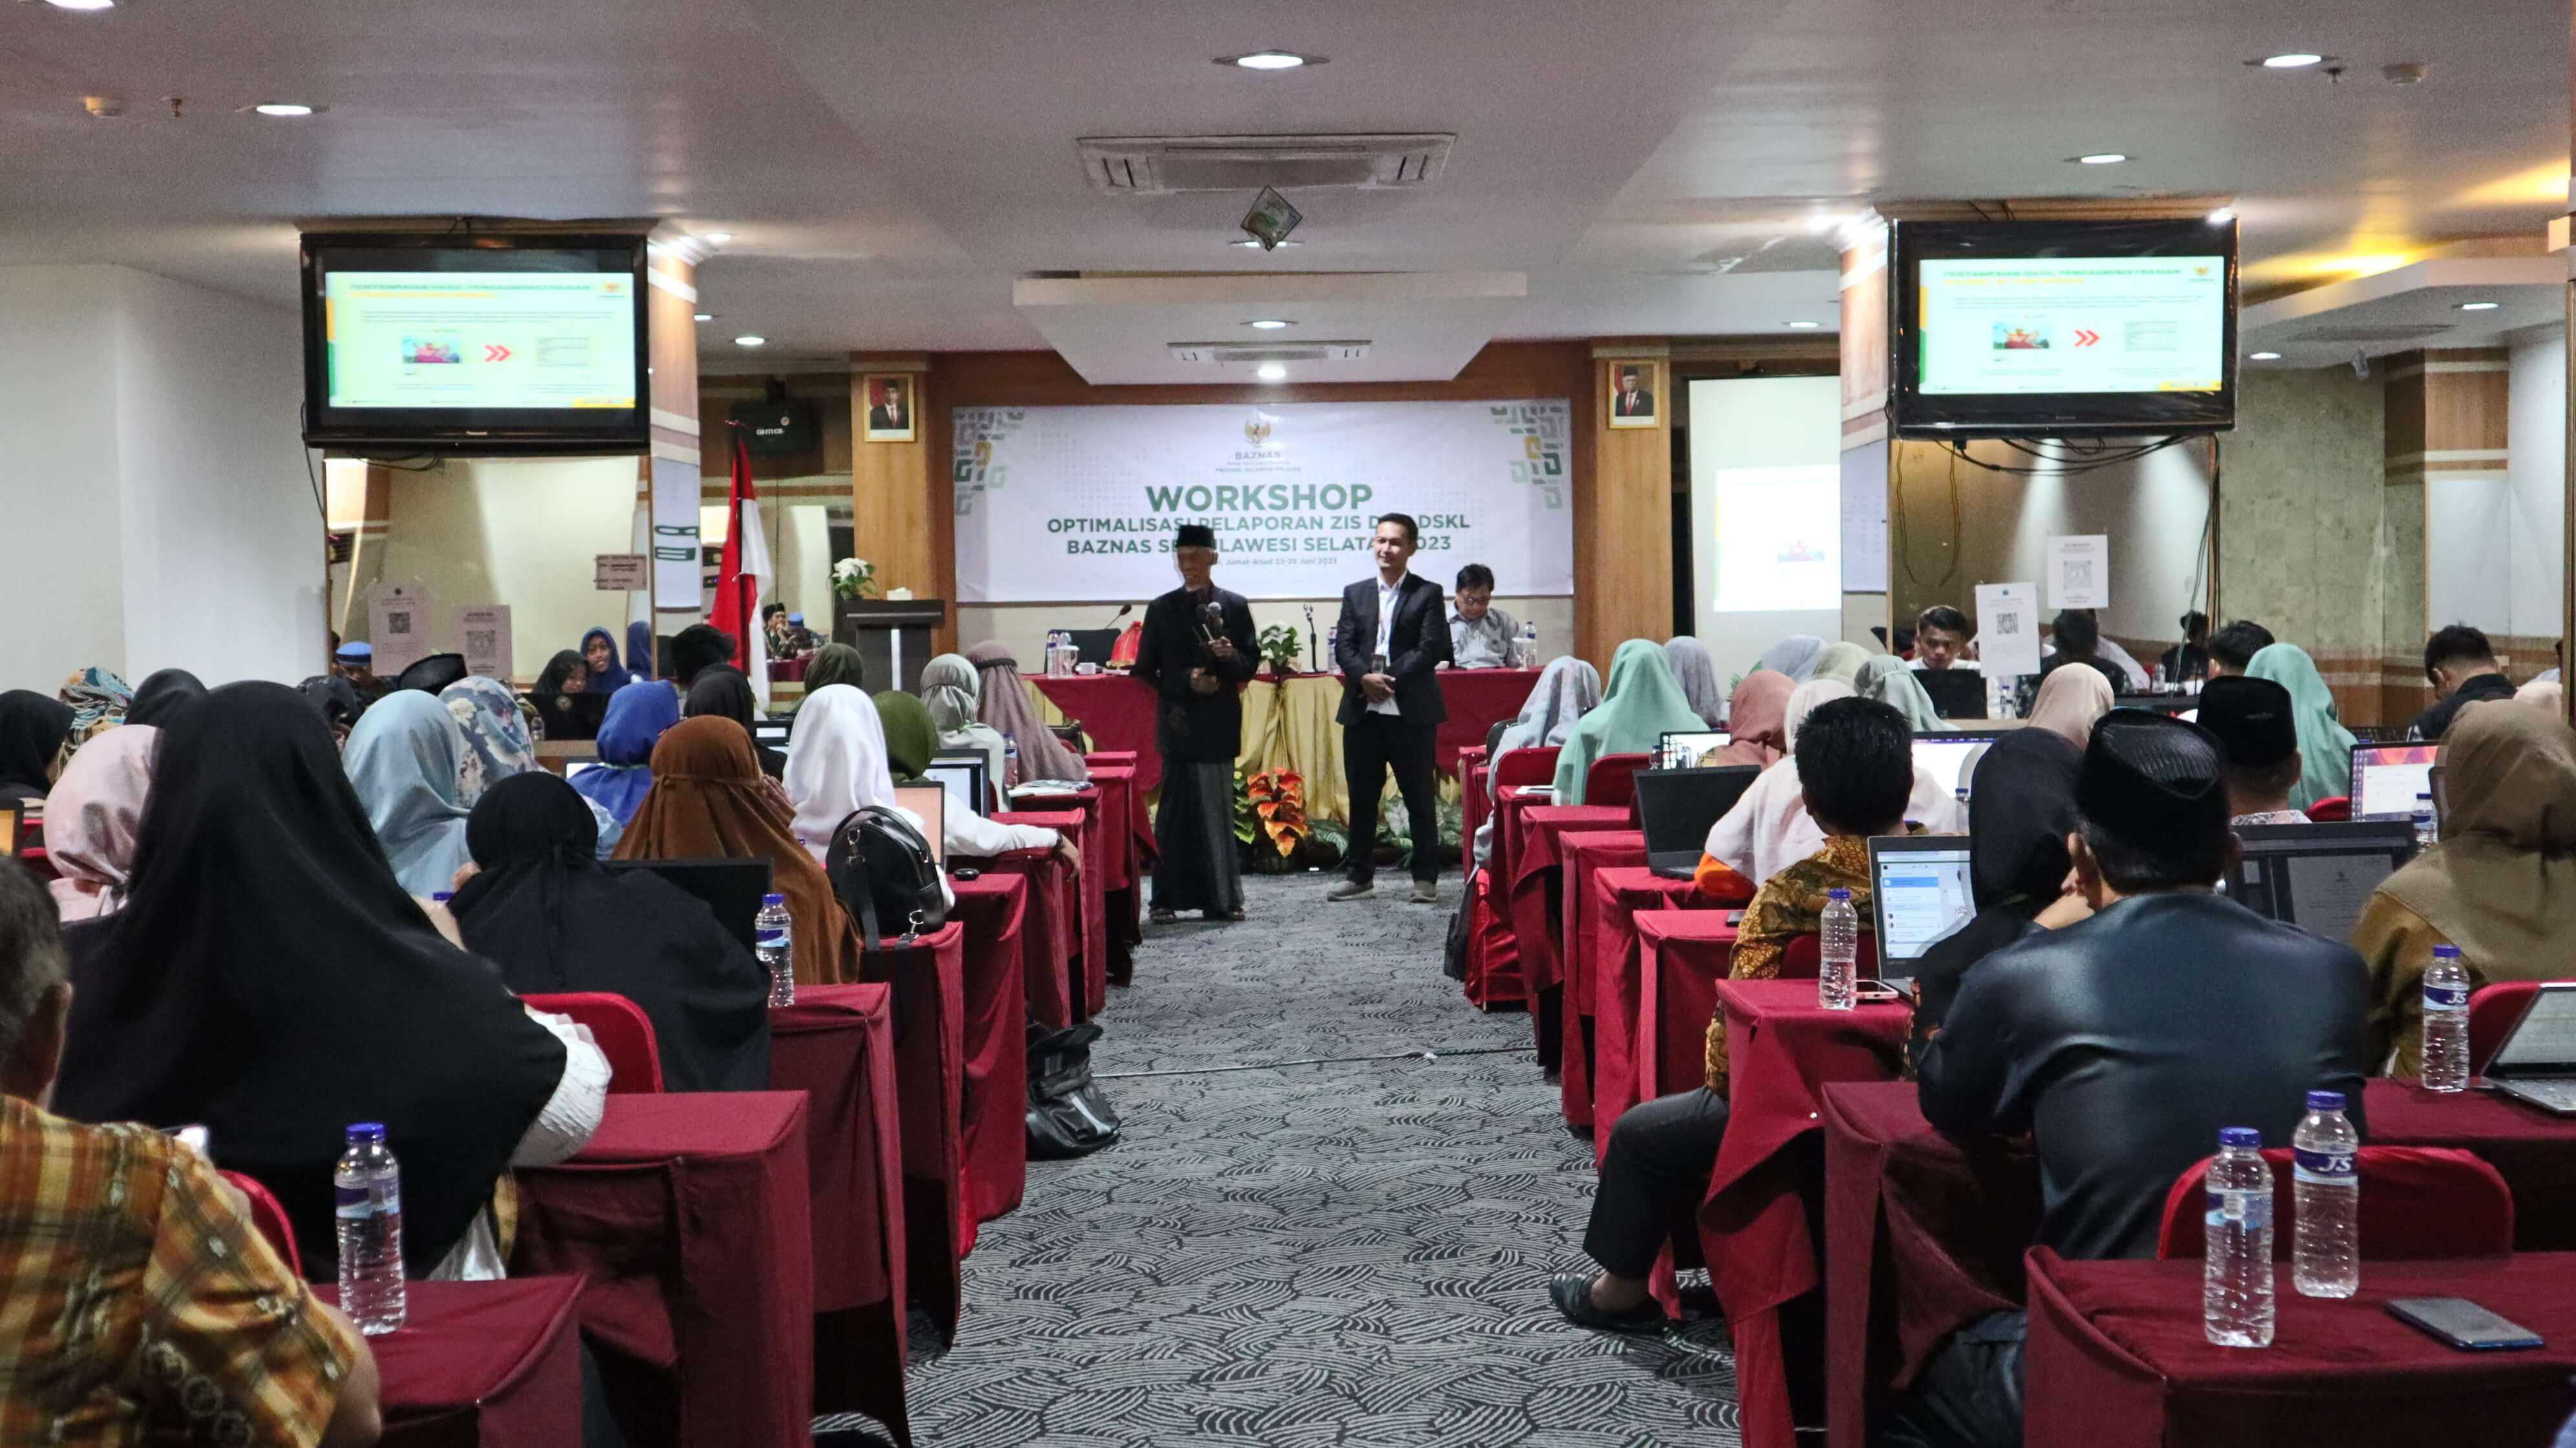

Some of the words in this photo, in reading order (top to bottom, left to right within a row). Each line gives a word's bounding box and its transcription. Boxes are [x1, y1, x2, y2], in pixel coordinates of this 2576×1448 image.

[1234, 451, 1282, 460] BAZNAS
[1145, 484, 1373, 513] WORKSHOP
[1330, 515, 1361, 529] ZIS
[1419, 514, 1470, 528] DSKL
[1067, 539, 1152, 554] BAZNAS
[1304, 537, 1376, 551] SELATA
[1417, 536, 1451, 549] 023
[2318, 1156, 2353, 1172] JS
